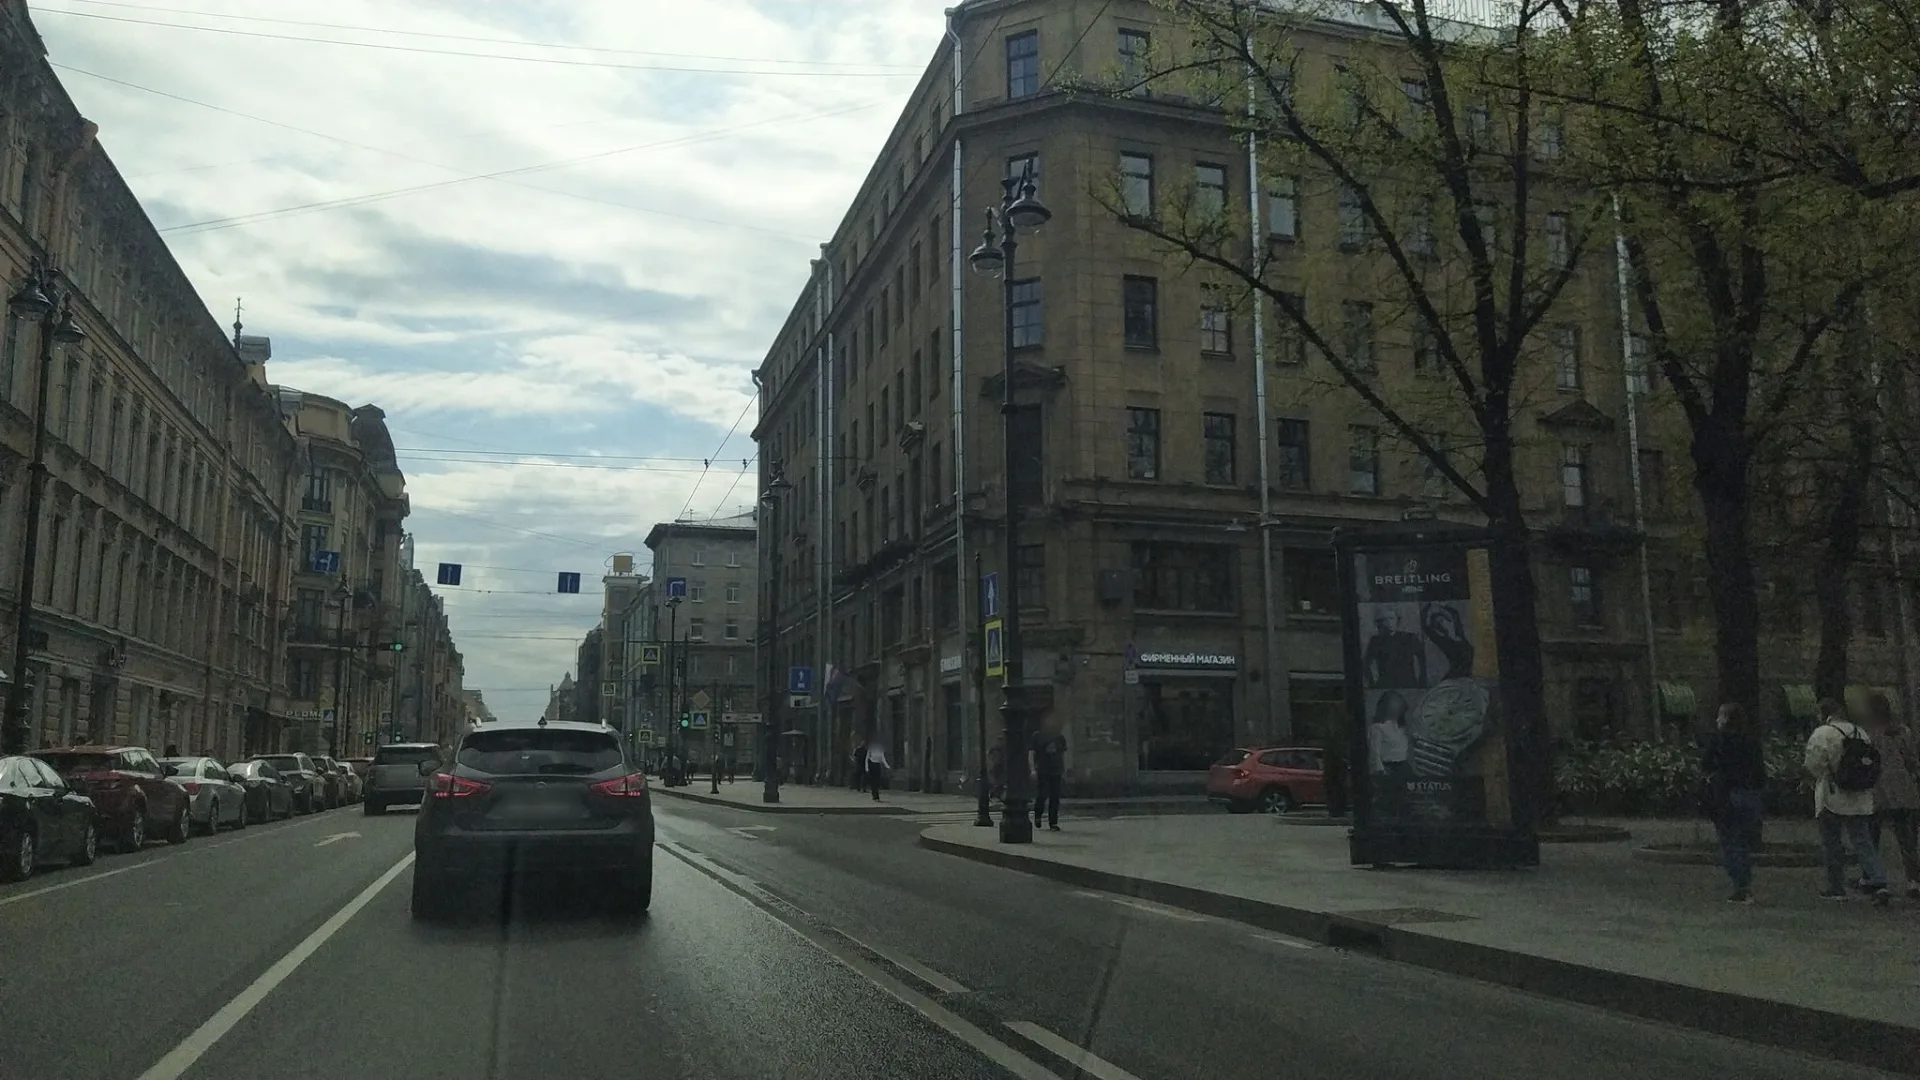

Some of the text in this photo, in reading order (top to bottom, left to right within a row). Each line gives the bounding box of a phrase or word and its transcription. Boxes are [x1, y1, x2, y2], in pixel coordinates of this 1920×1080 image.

[1375, 573, 1451, 585] BREITLING
[1140, 653, 1235, 665] ФИРМЕННЫЙ МАГАЗИН
